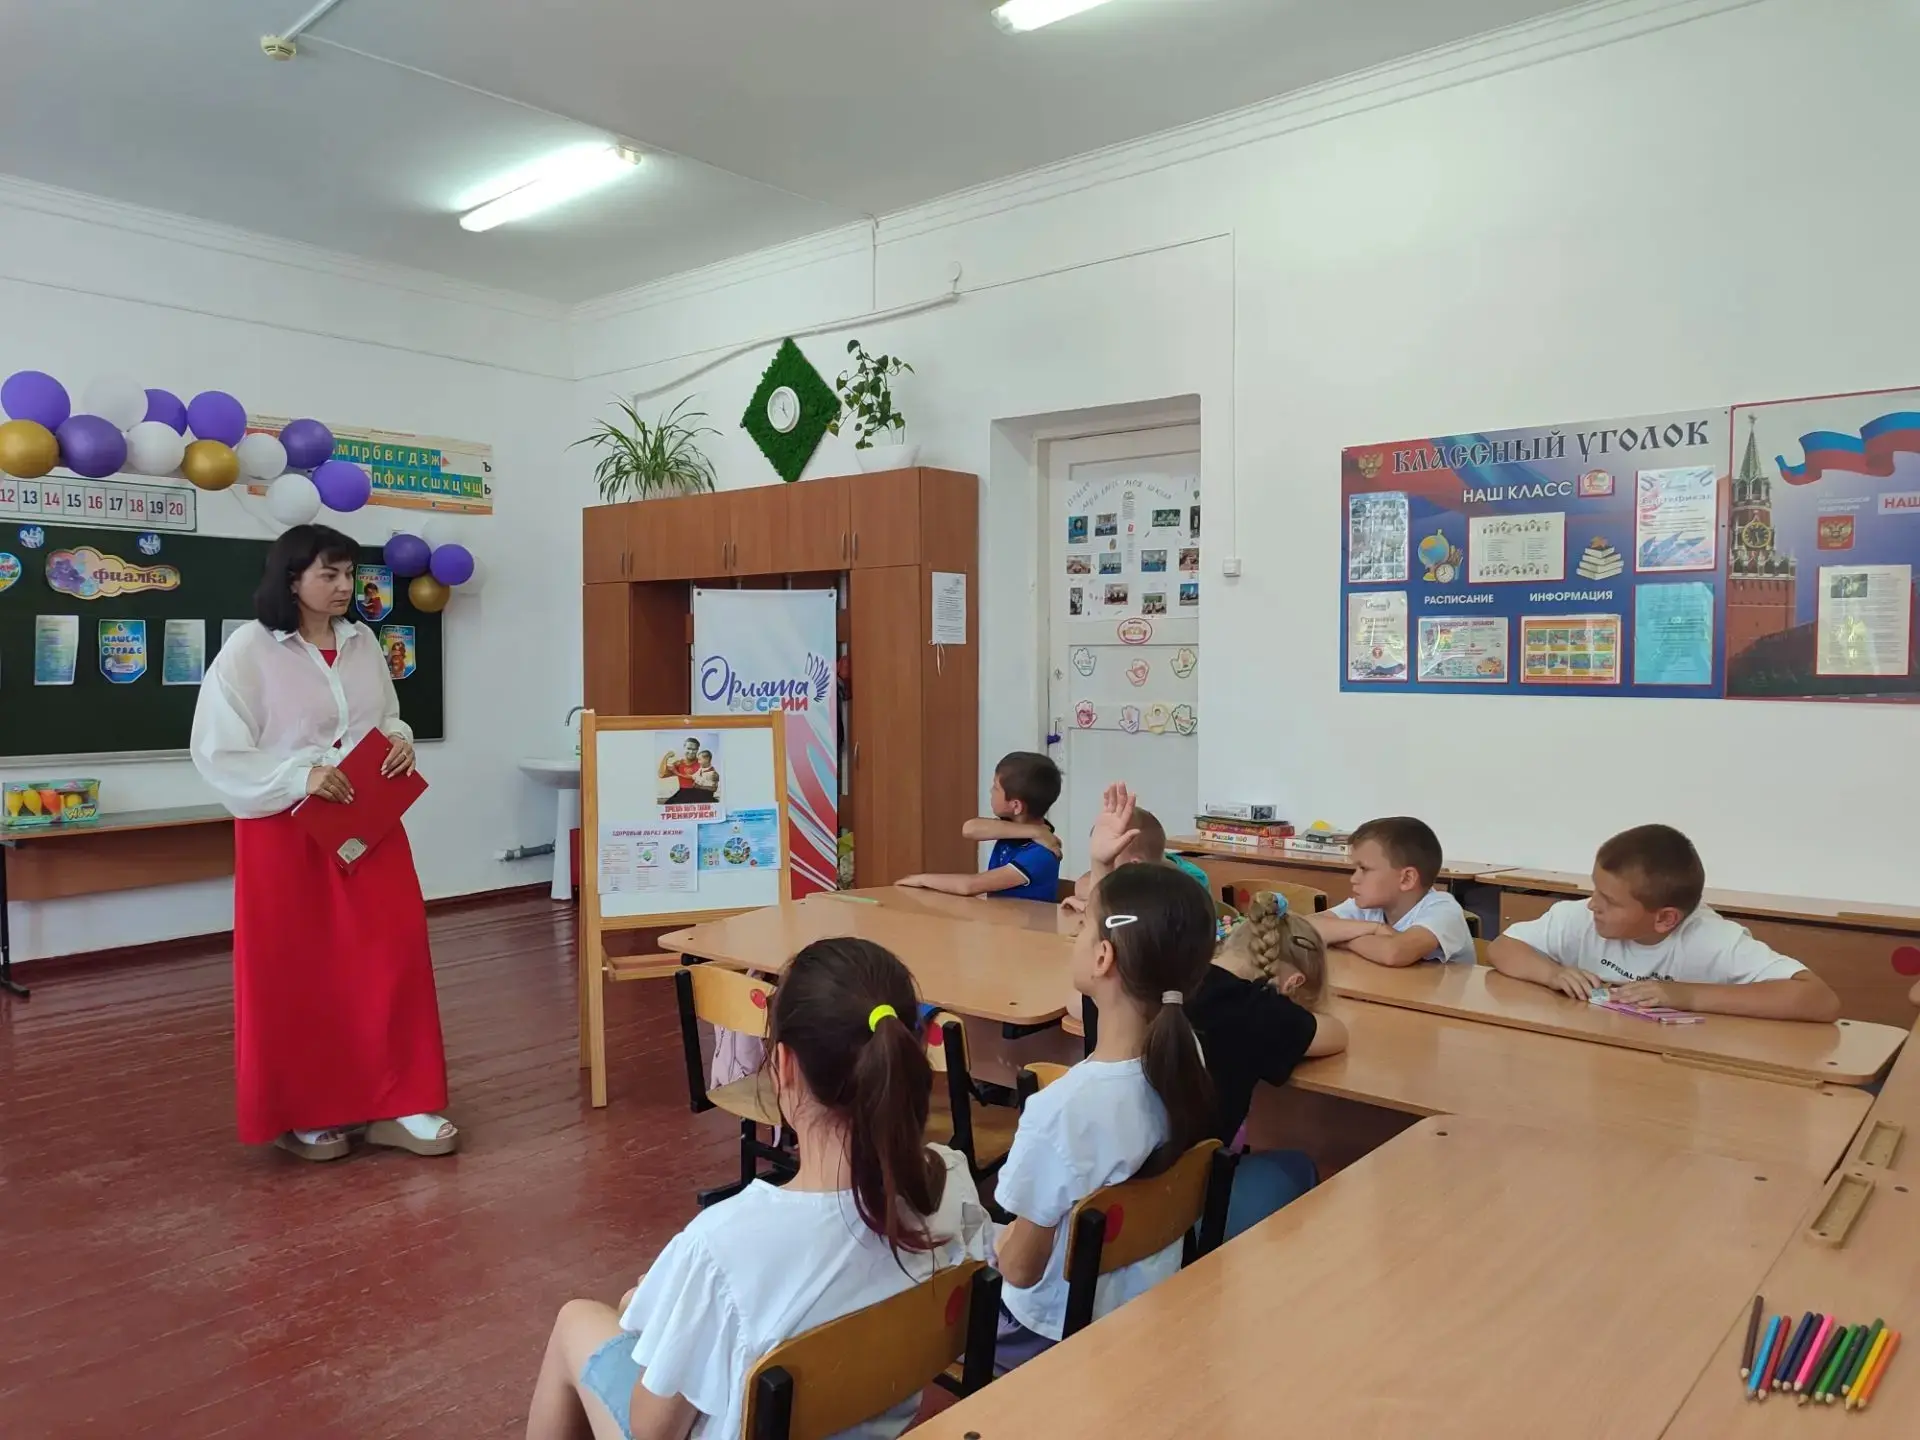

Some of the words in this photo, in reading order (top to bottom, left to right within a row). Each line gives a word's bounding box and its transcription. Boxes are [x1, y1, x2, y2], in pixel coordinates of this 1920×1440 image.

[1392, 430, 1566, 474] КЛАССНЫЙ
[1575, 420, 1710, 464] УГОЛОК
[22, 490, 37, 505] 13
[44, 492, 60, 507] 14
[67, 494, 82, 508] 15
[88, 495, 103, 510] 16
[109, 497, 123, 511] 17
[130, 499, 144, 513] 18
[150, 501, 164, 514] 19
[169, 502, 184, 516] 20
[1464, 486, 1503, 503] НАШ
[1508, 481, 1573, 500] КЛАСС
[1424, 593, 1495, 605] РАСПИСАНИЕ
[1529, 590, 1613, 603] ИНФОРМАЦИЯ
[700, 655, 809, 706] Орлята
[728, 696, 808, 712] РОССИИ
[1600, 958, 1635, 980] OFFICIAL
